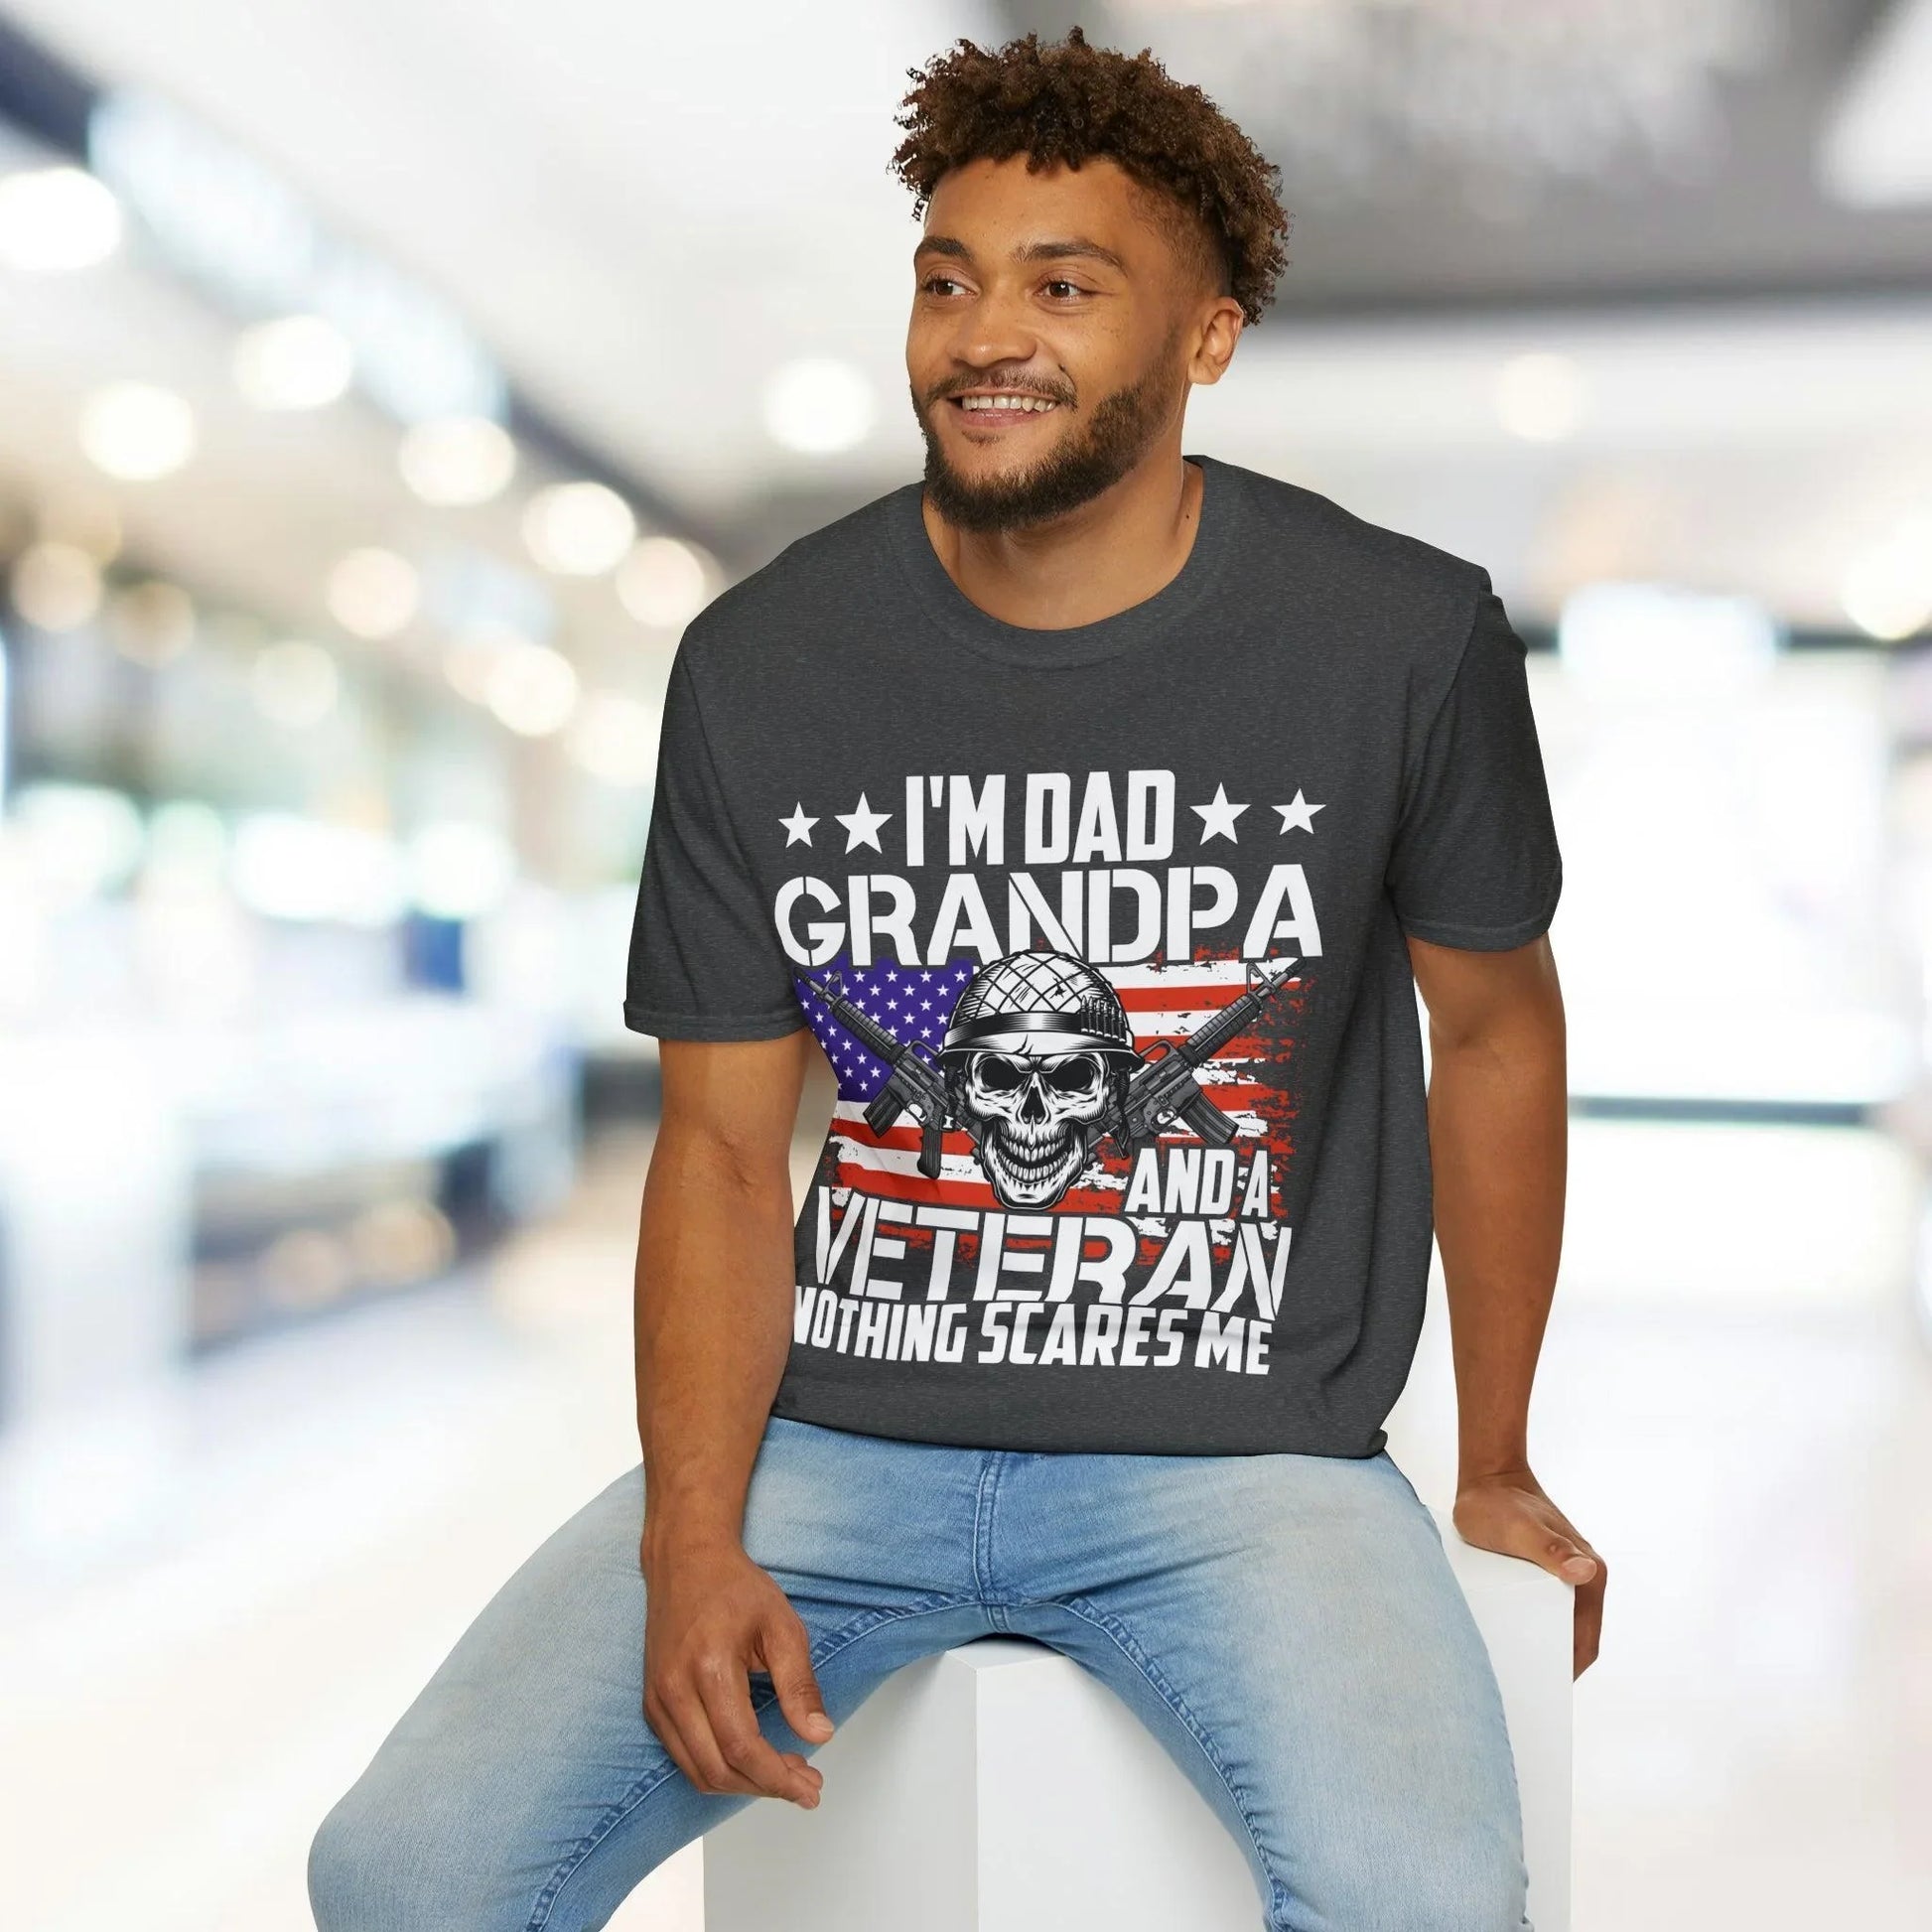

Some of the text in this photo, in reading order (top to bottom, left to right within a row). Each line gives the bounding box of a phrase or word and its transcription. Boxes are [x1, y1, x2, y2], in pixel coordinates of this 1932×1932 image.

[905, 769, 1175, 867] I'M DAD
[774, 864, 1323, 967] GRANDPA
[1124, 1148, 1269, 1217] AND A
[816, 1185, 1292, 1319] VETERAN
[793, 1286, 1273, 1375] NOTHING SCARES ME
